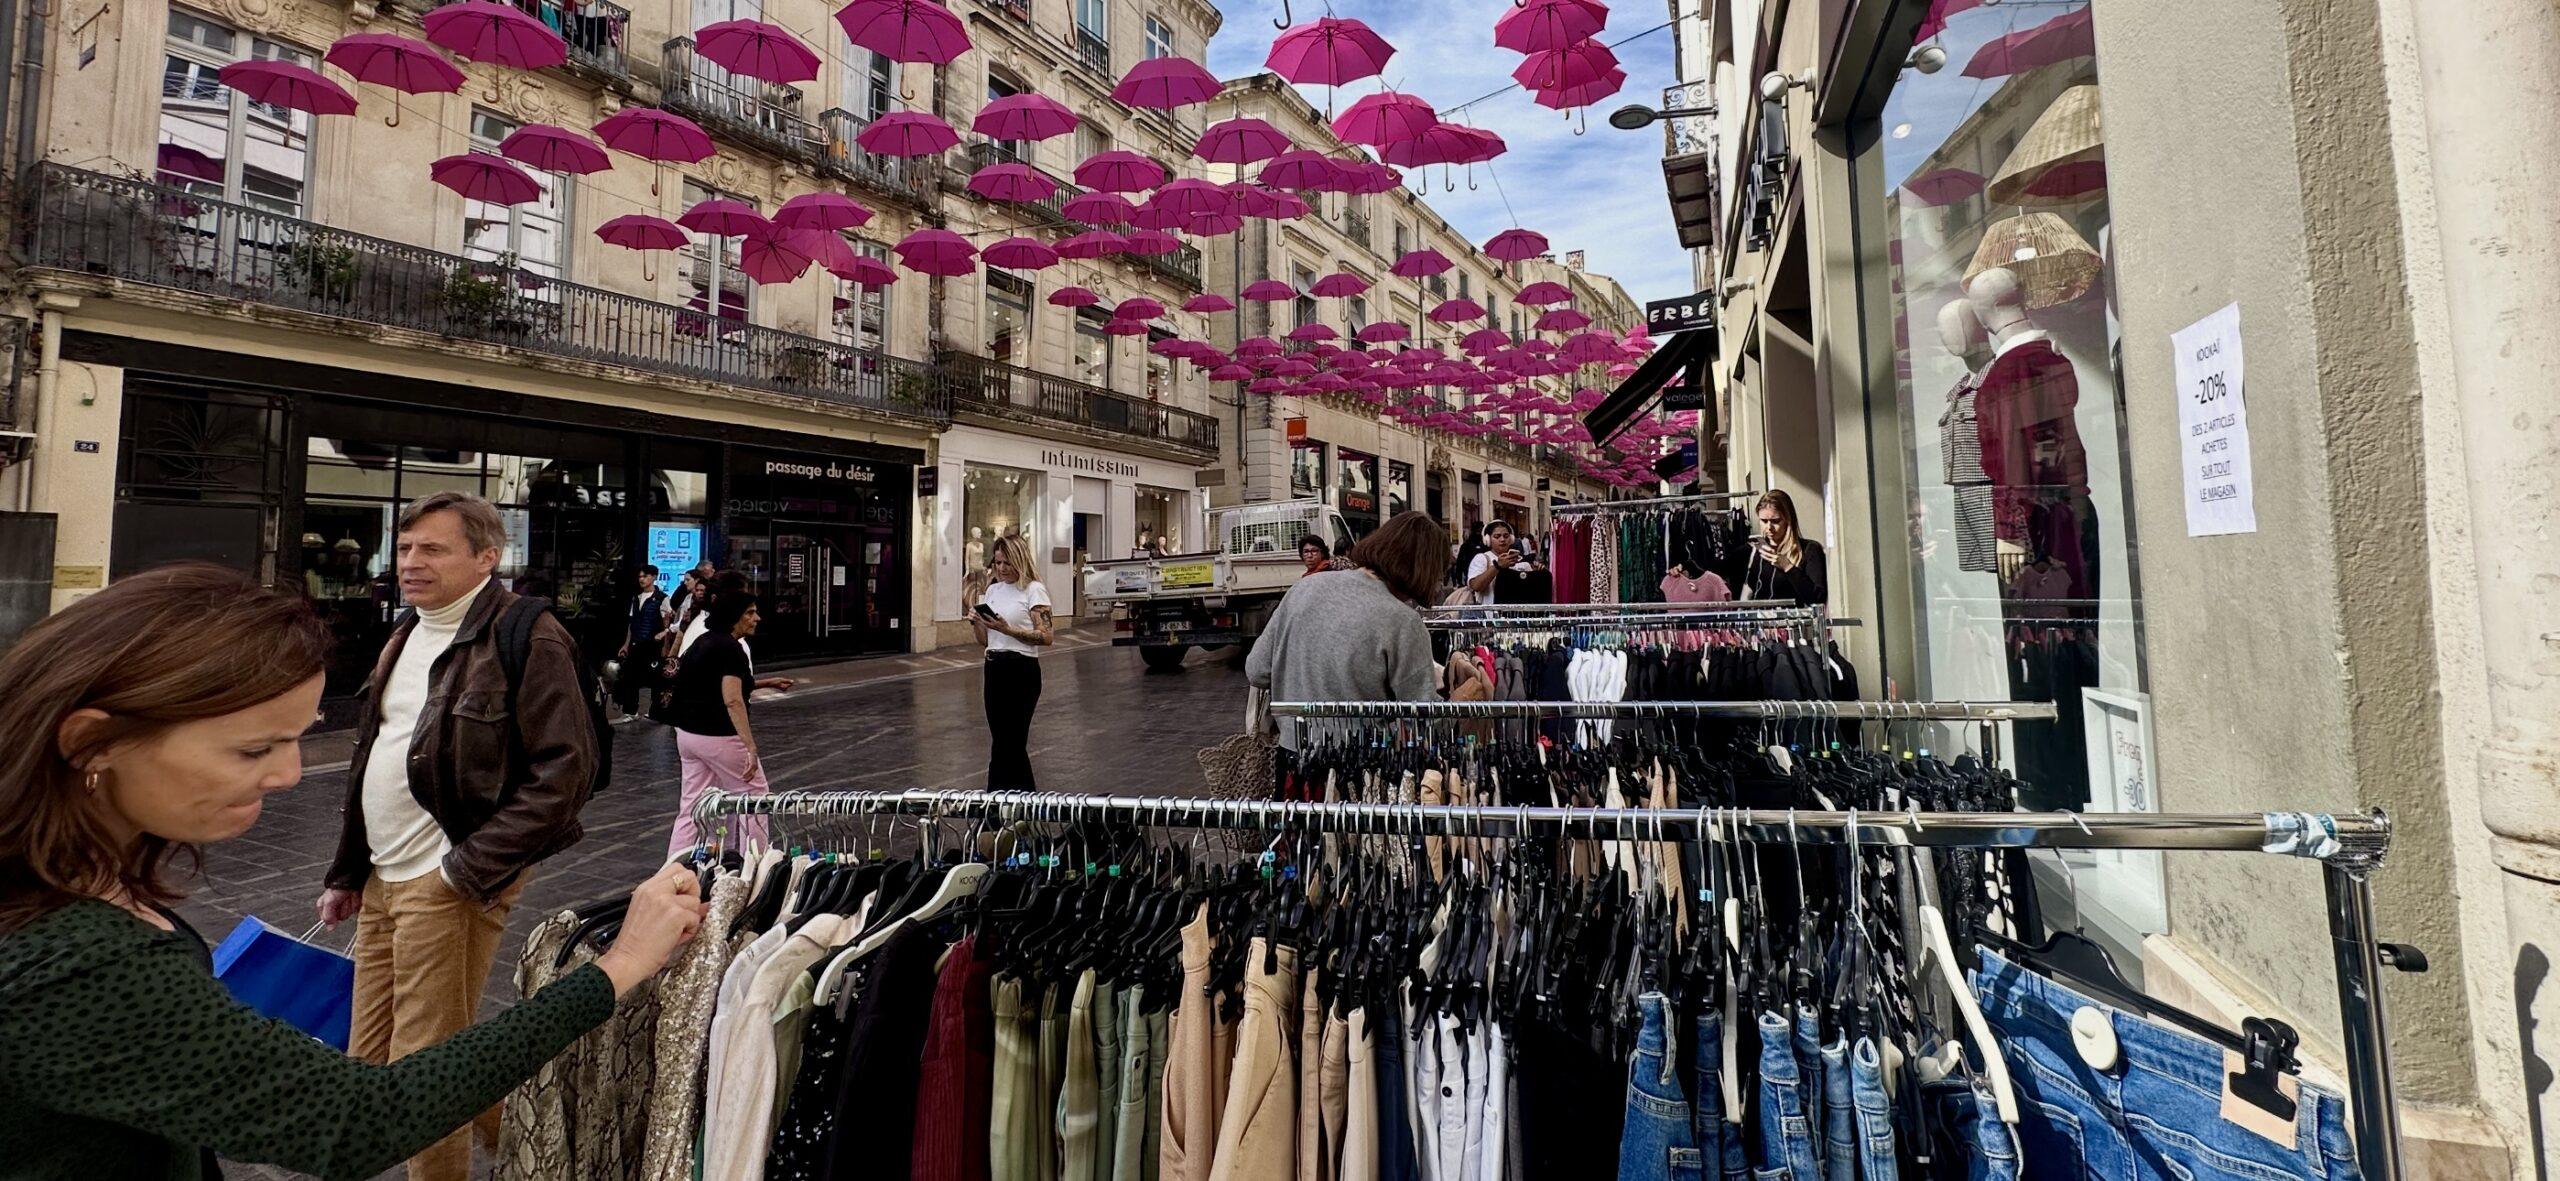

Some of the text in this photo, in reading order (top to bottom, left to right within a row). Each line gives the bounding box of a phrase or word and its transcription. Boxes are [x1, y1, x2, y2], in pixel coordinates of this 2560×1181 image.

[1649, 299, 1710, 323] ERBÉ
[2194, 370, 2227, 404] -20%
[2191, 423, 2203, 437] DES
[2209, 413, 2236, 431] ARTICLES
[765, 461, 875, 482] passage du désir
[2201, 460, 2231, 477] SUR TOUT
[2200, 483, 2237, 500] LE MAGASIN
[1346, 494, 1371, 511] Orange
